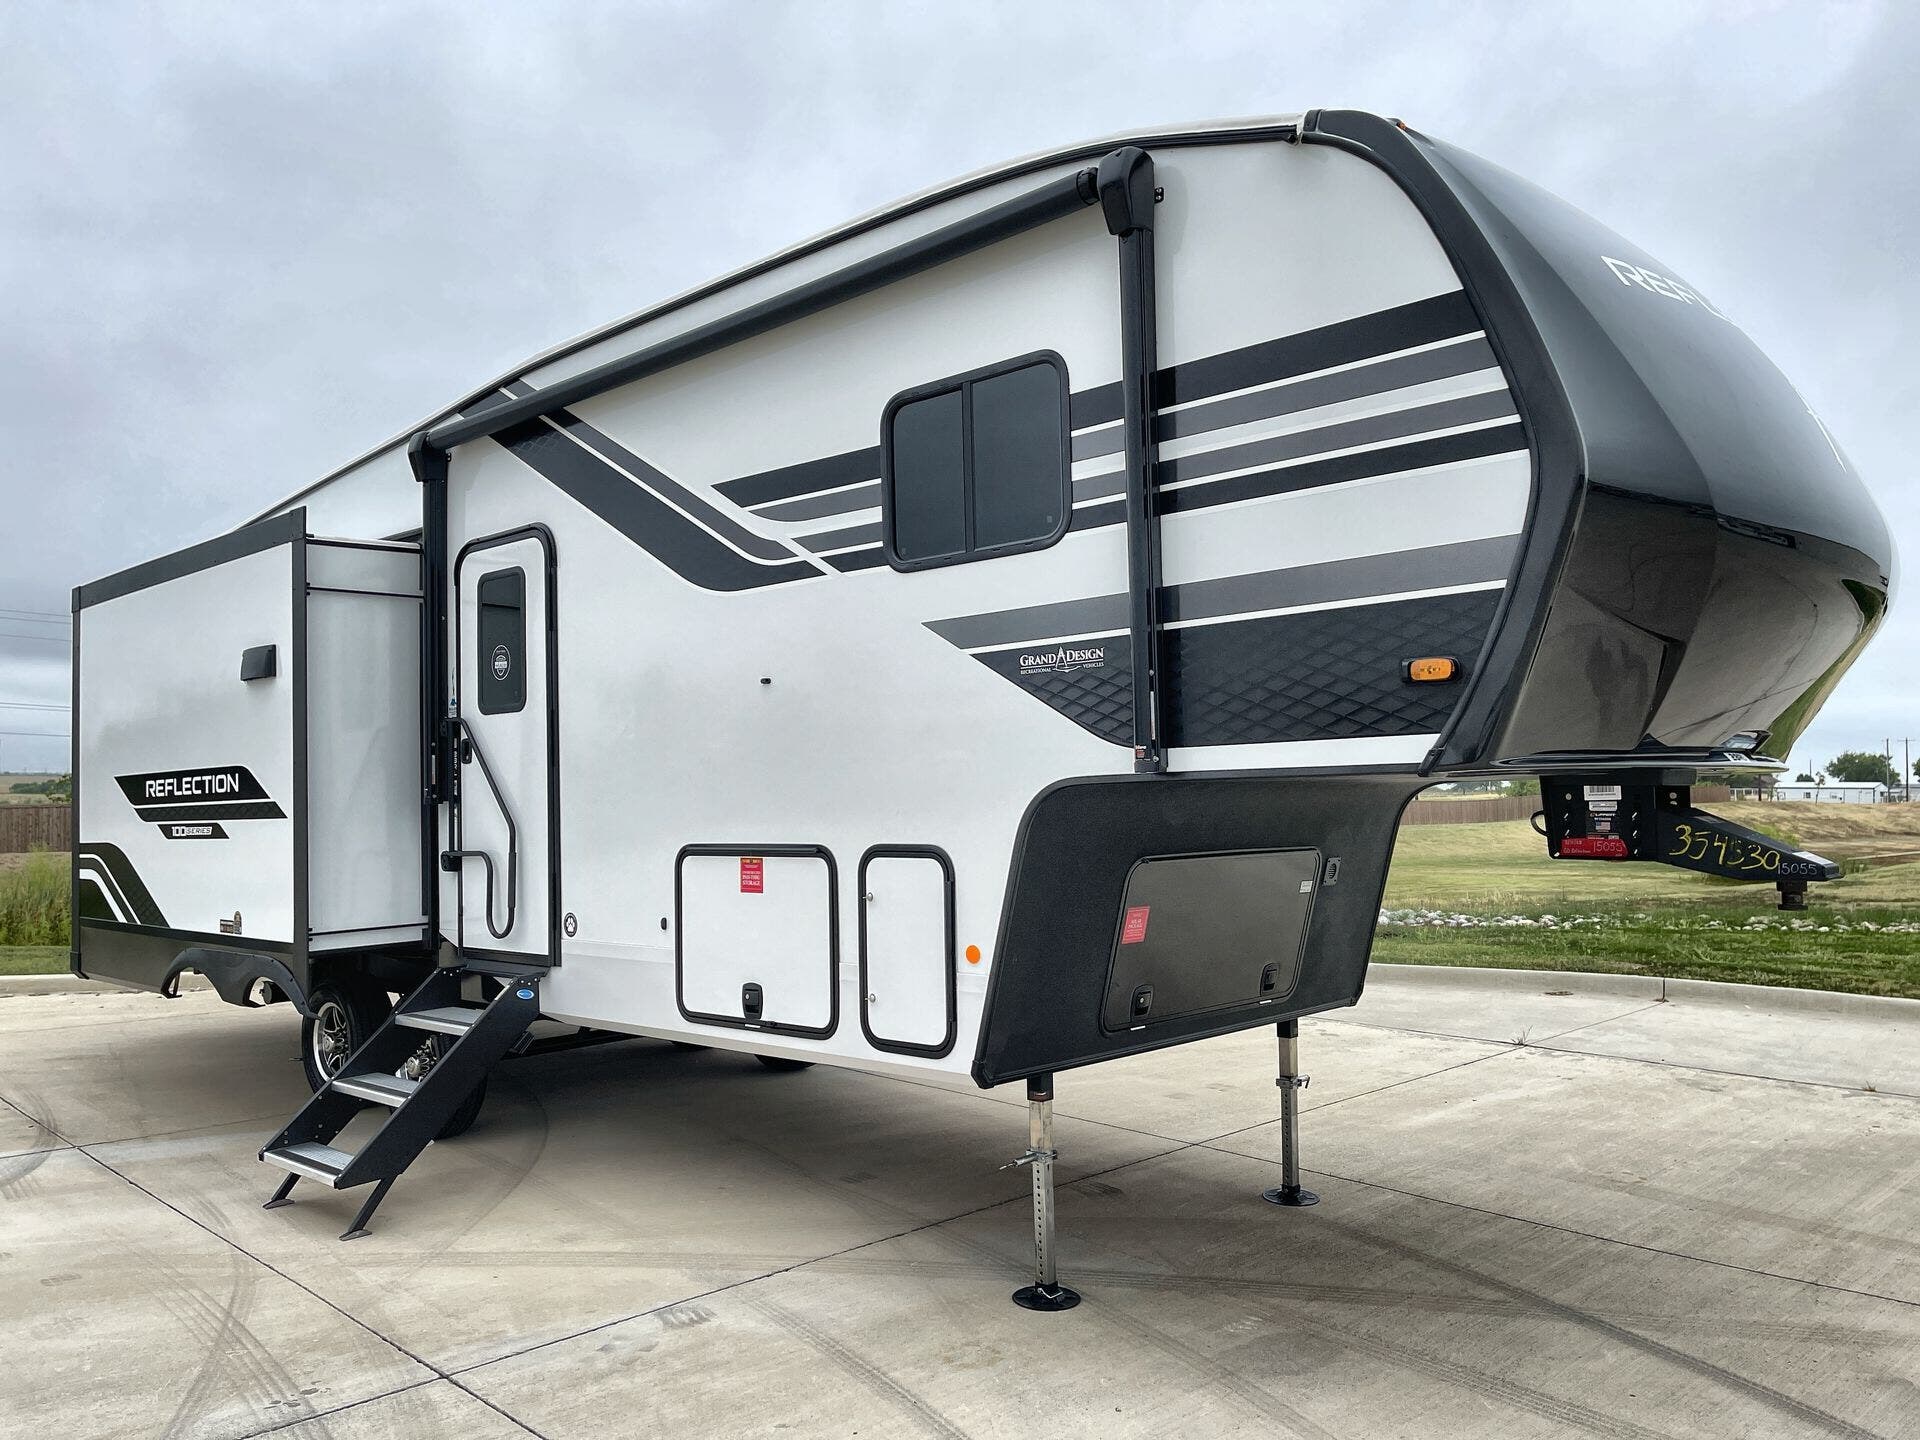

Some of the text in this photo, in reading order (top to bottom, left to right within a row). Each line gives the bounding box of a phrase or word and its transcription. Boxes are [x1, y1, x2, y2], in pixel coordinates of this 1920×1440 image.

[1066, 647, 1104, 662] DESIGN
[145, 773, 239, 798] REFLECTION
[1593, 840, 1623, 853] 15055
[1777, 862, 1818, 876] 15055
